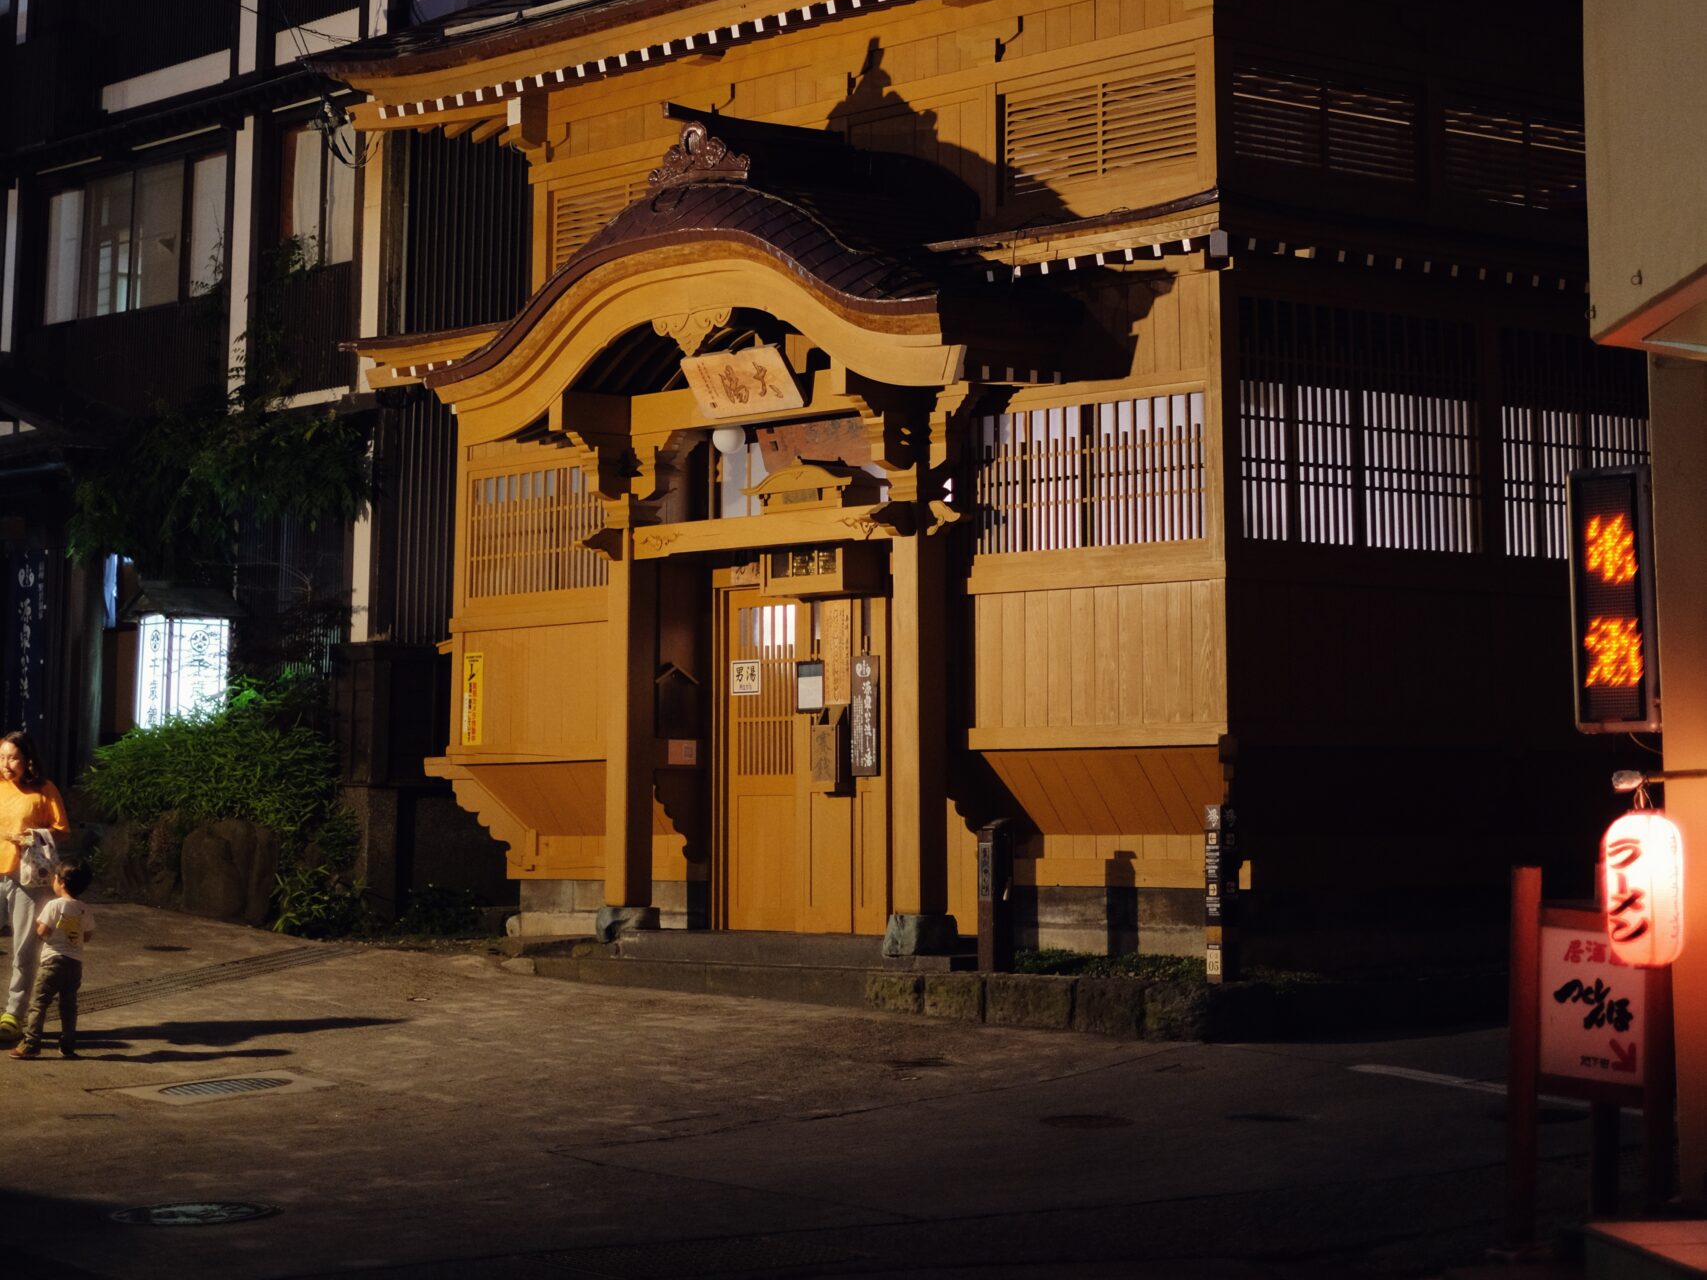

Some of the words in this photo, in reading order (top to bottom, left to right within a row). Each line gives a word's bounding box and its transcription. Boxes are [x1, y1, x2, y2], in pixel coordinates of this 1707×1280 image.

[735, 665, 757, 682] 男湯
[1608, 837, 1649, 942] ラーメン
[1564, 939, 1628, 967] 居酒
